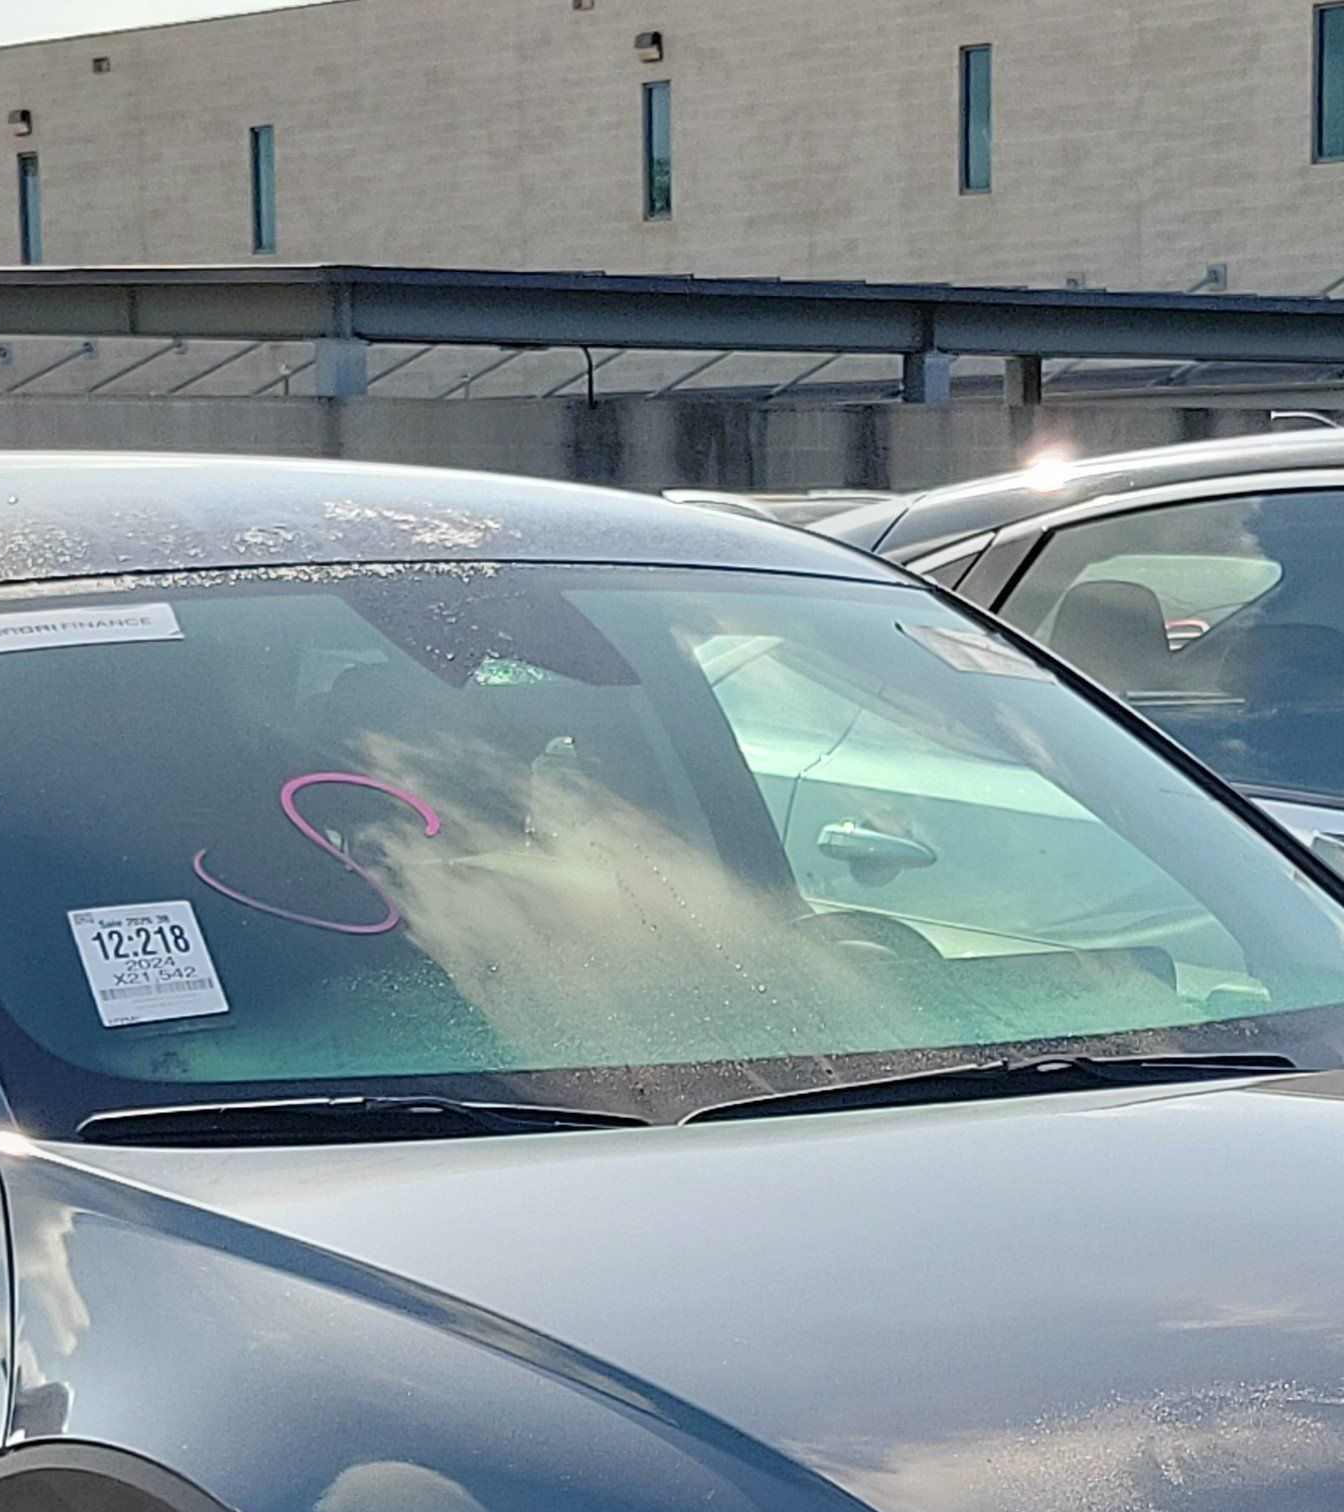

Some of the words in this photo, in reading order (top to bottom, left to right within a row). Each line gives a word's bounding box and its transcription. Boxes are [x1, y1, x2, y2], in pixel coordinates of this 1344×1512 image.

[60, 617, 153, 631] FINANCE
[91, 925, 191, 960] 12:218
[125, 955, 176, 972] 2024
